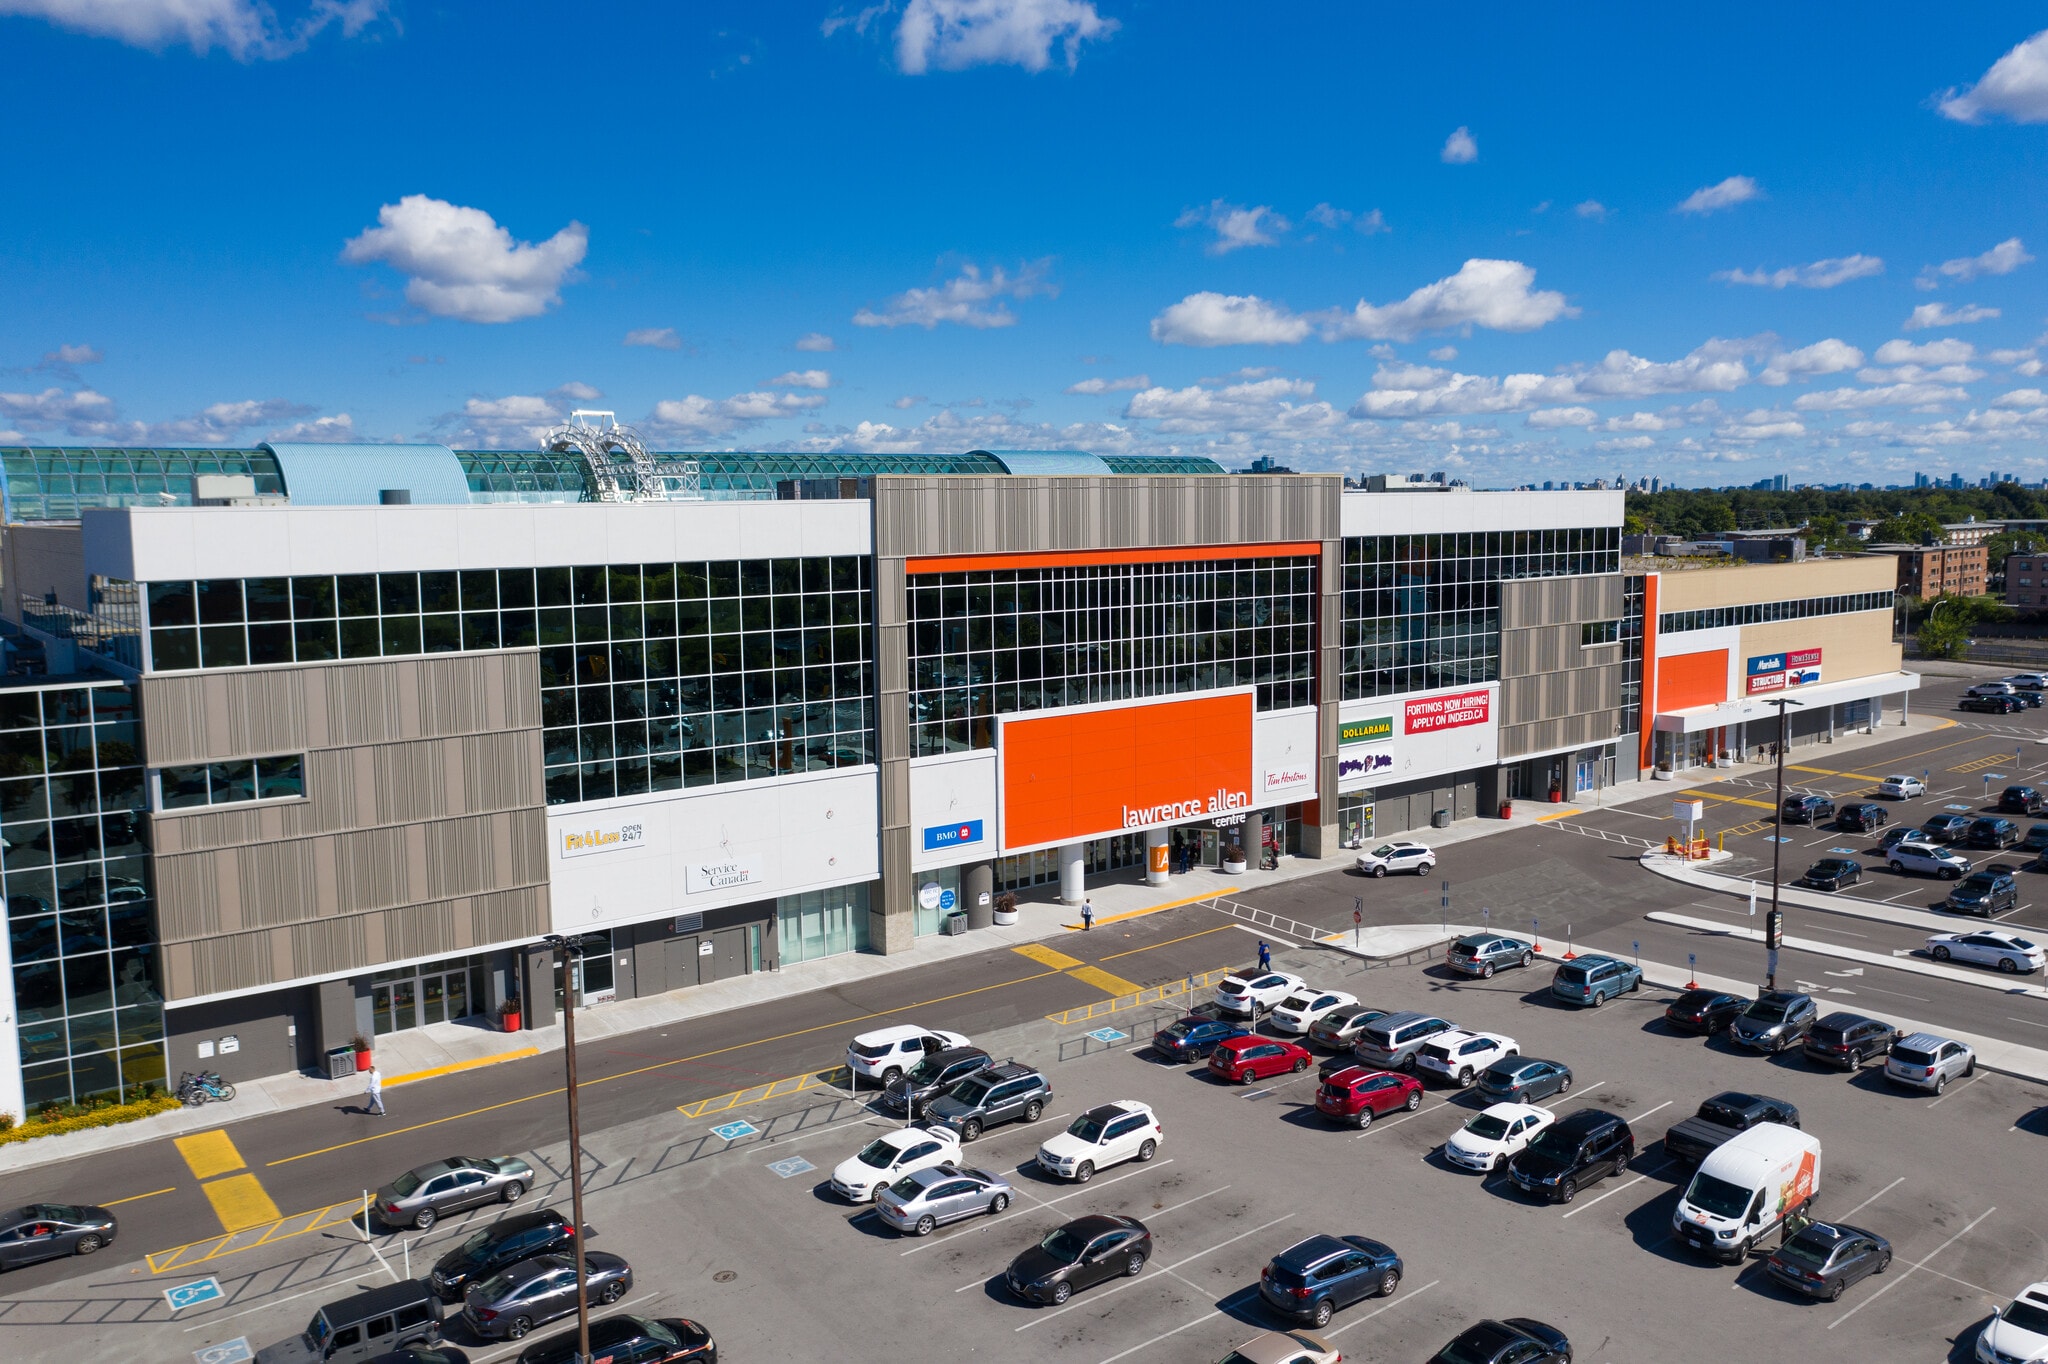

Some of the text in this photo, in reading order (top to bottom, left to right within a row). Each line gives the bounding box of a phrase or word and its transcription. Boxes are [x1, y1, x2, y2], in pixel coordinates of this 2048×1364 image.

[1752, 674, 1784, 688] STRUCTUBE
[1406, 694, 1488, 717] FORTINOS NOW HIRING!
[1412, 709, 1484, 730] APPLY ON INDEED.CA
[1343, 723, 1390, 738] DOLLARAMA
[1266, 770, 1307, 786] Tim Hortons
[1122, 788, 1247, 828] lawrence allen
[1215, 813, 1246, 828] centre
[621, 824, 642, 833] OPEN
[622, 830, 642, 842] 24/7
[936, 830, 957, 841] BMO
[700, 863, 738, 877] Service
[709, 871, 749, 887] Canada
